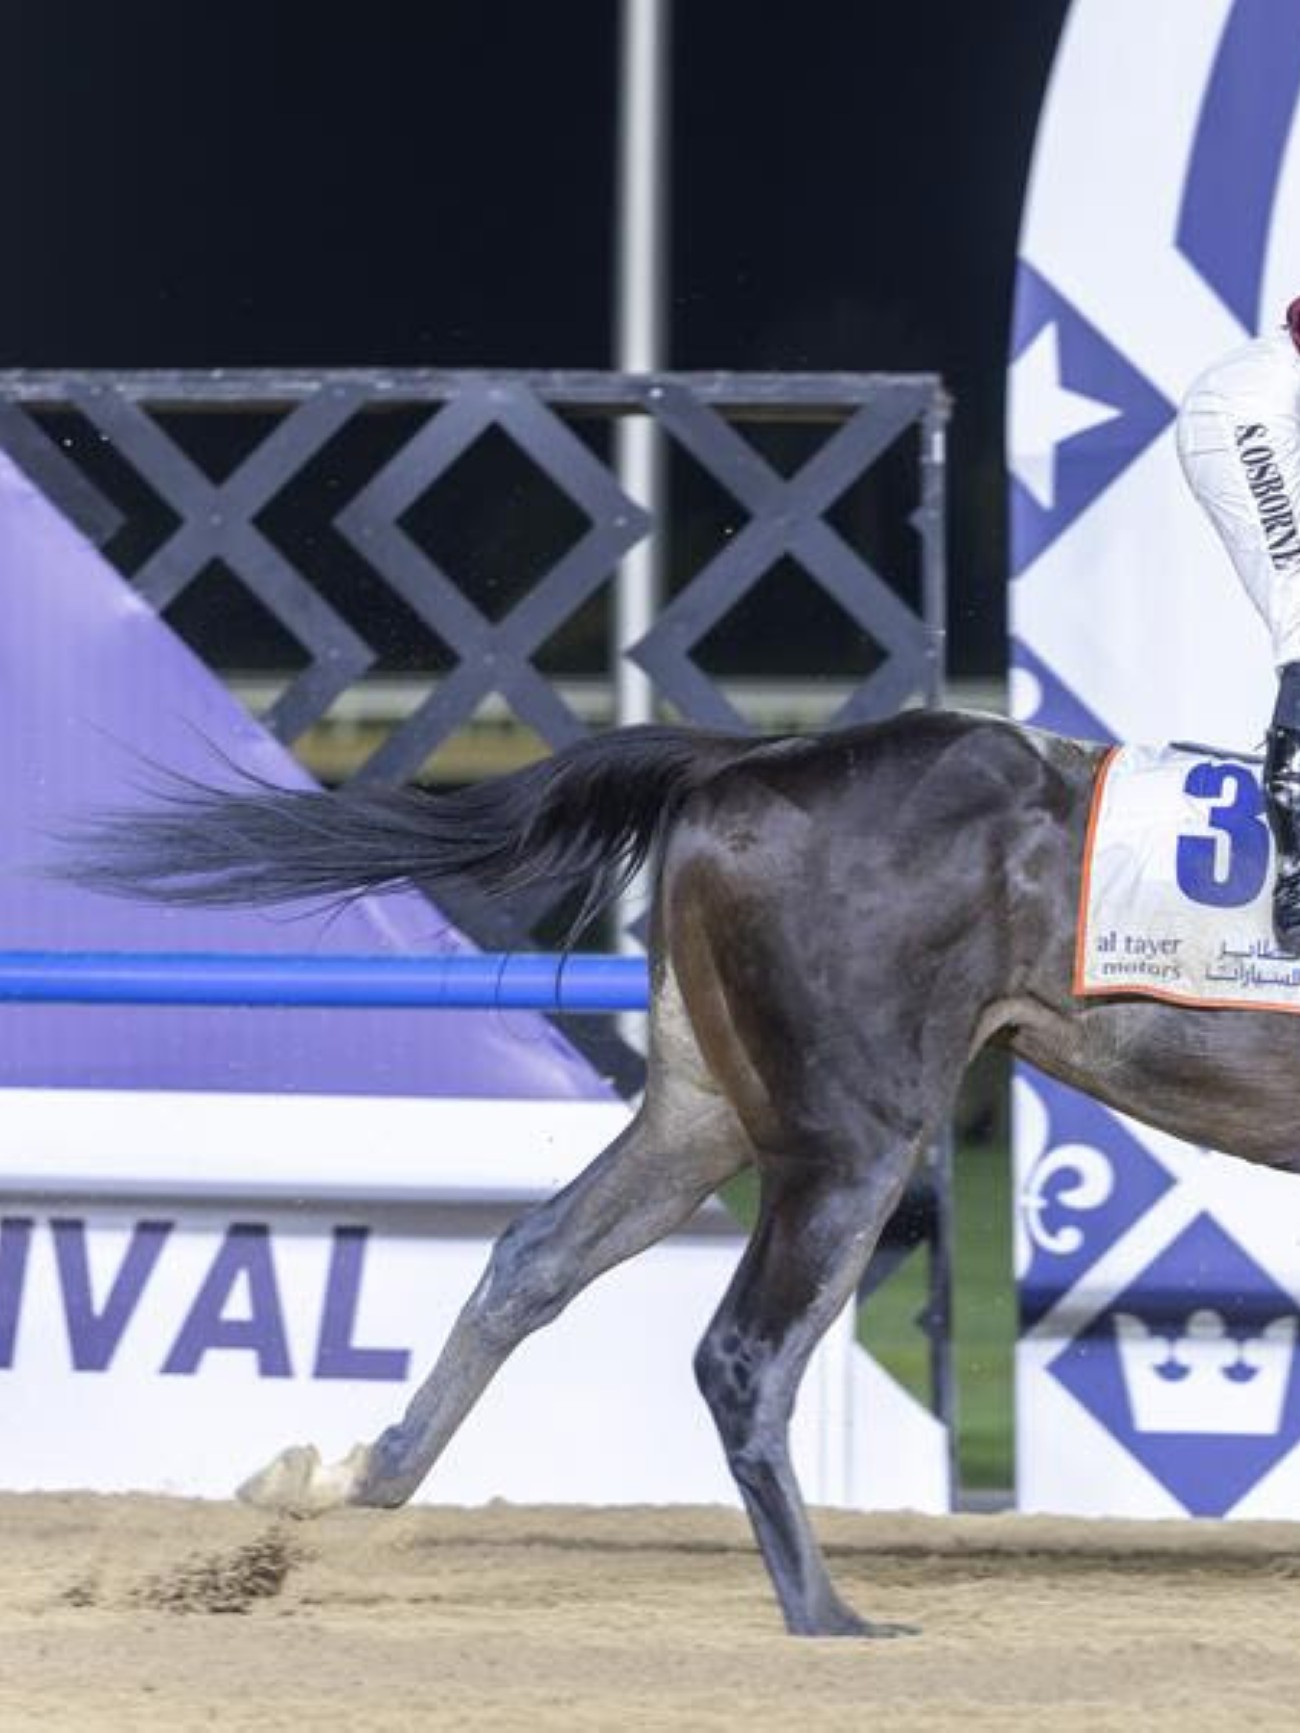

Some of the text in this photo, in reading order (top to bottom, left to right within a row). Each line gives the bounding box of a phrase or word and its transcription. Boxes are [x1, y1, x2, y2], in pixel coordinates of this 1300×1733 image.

[1175, 761, 1271, 909] 3
[1097, 931, 1184, 960] al tayer
[1102, 960, 1181, 981] motors
